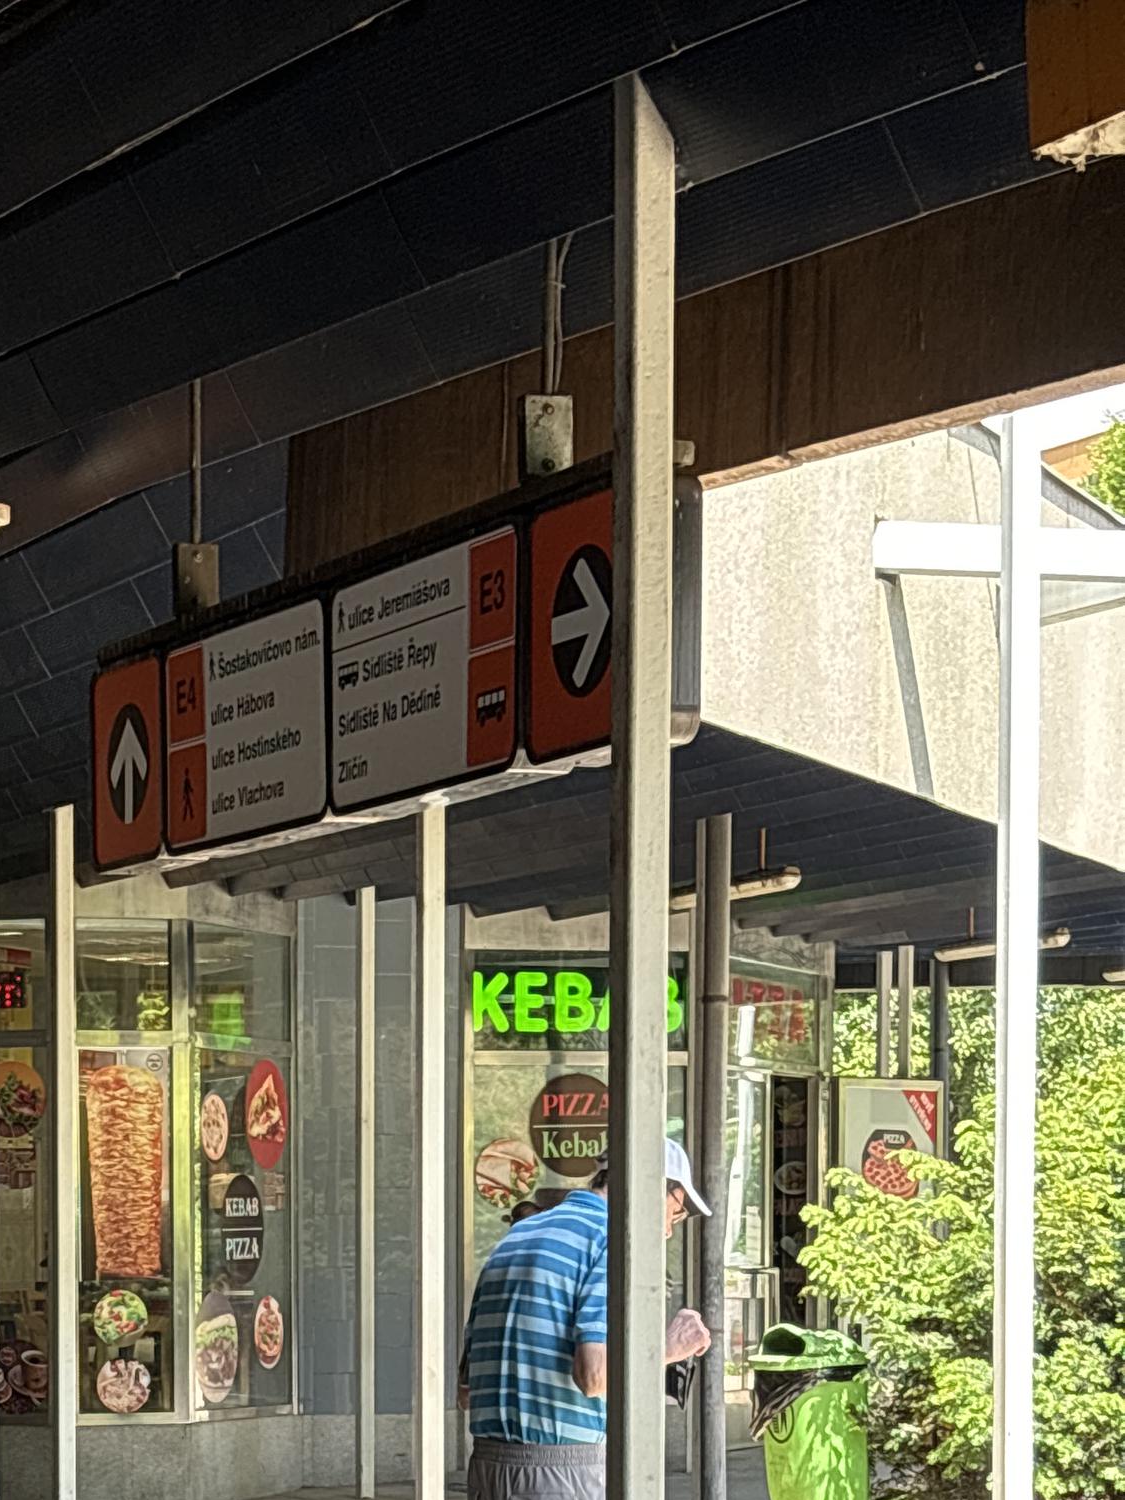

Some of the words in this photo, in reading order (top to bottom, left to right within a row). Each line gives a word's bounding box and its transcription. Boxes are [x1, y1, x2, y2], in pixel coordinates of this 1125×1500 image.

[348, 605, 374, 631] ulice
[378, 577, 450, 620] Jeremiášova
[480, 569, 506, 615] E3
[218, 639, 291, 679] Šostakovičovo
[295, 628, 320, 650] nám.
[363, 650, 403, 682] Sídliště
[408, 637, 437, 670] Řepy
[177, 677, 196, 714] E4
[211, 703, 234, 726] ulice
[237, 691, 275, 718] Hábova
[339, 706, 379, 737] Sídliště
[383, 700, 397, 727] Na
[402, 683, 441, 723] Dědině
[212, 746, 235, 770] ulice
[238, 727, 301, 763] Hostinského
[339, 755, 368, 784] Zličín
[212, 792, 235, 814] ulice
[238, 780, 284, 807] Vlachova
[473, 971, 682, 1032] KEB
[883, 1133, 905, 1145] PIZZA
[225, 1197, 259, 1217] KEBAB
[225, 1237, 259, 1261] PIZZA
